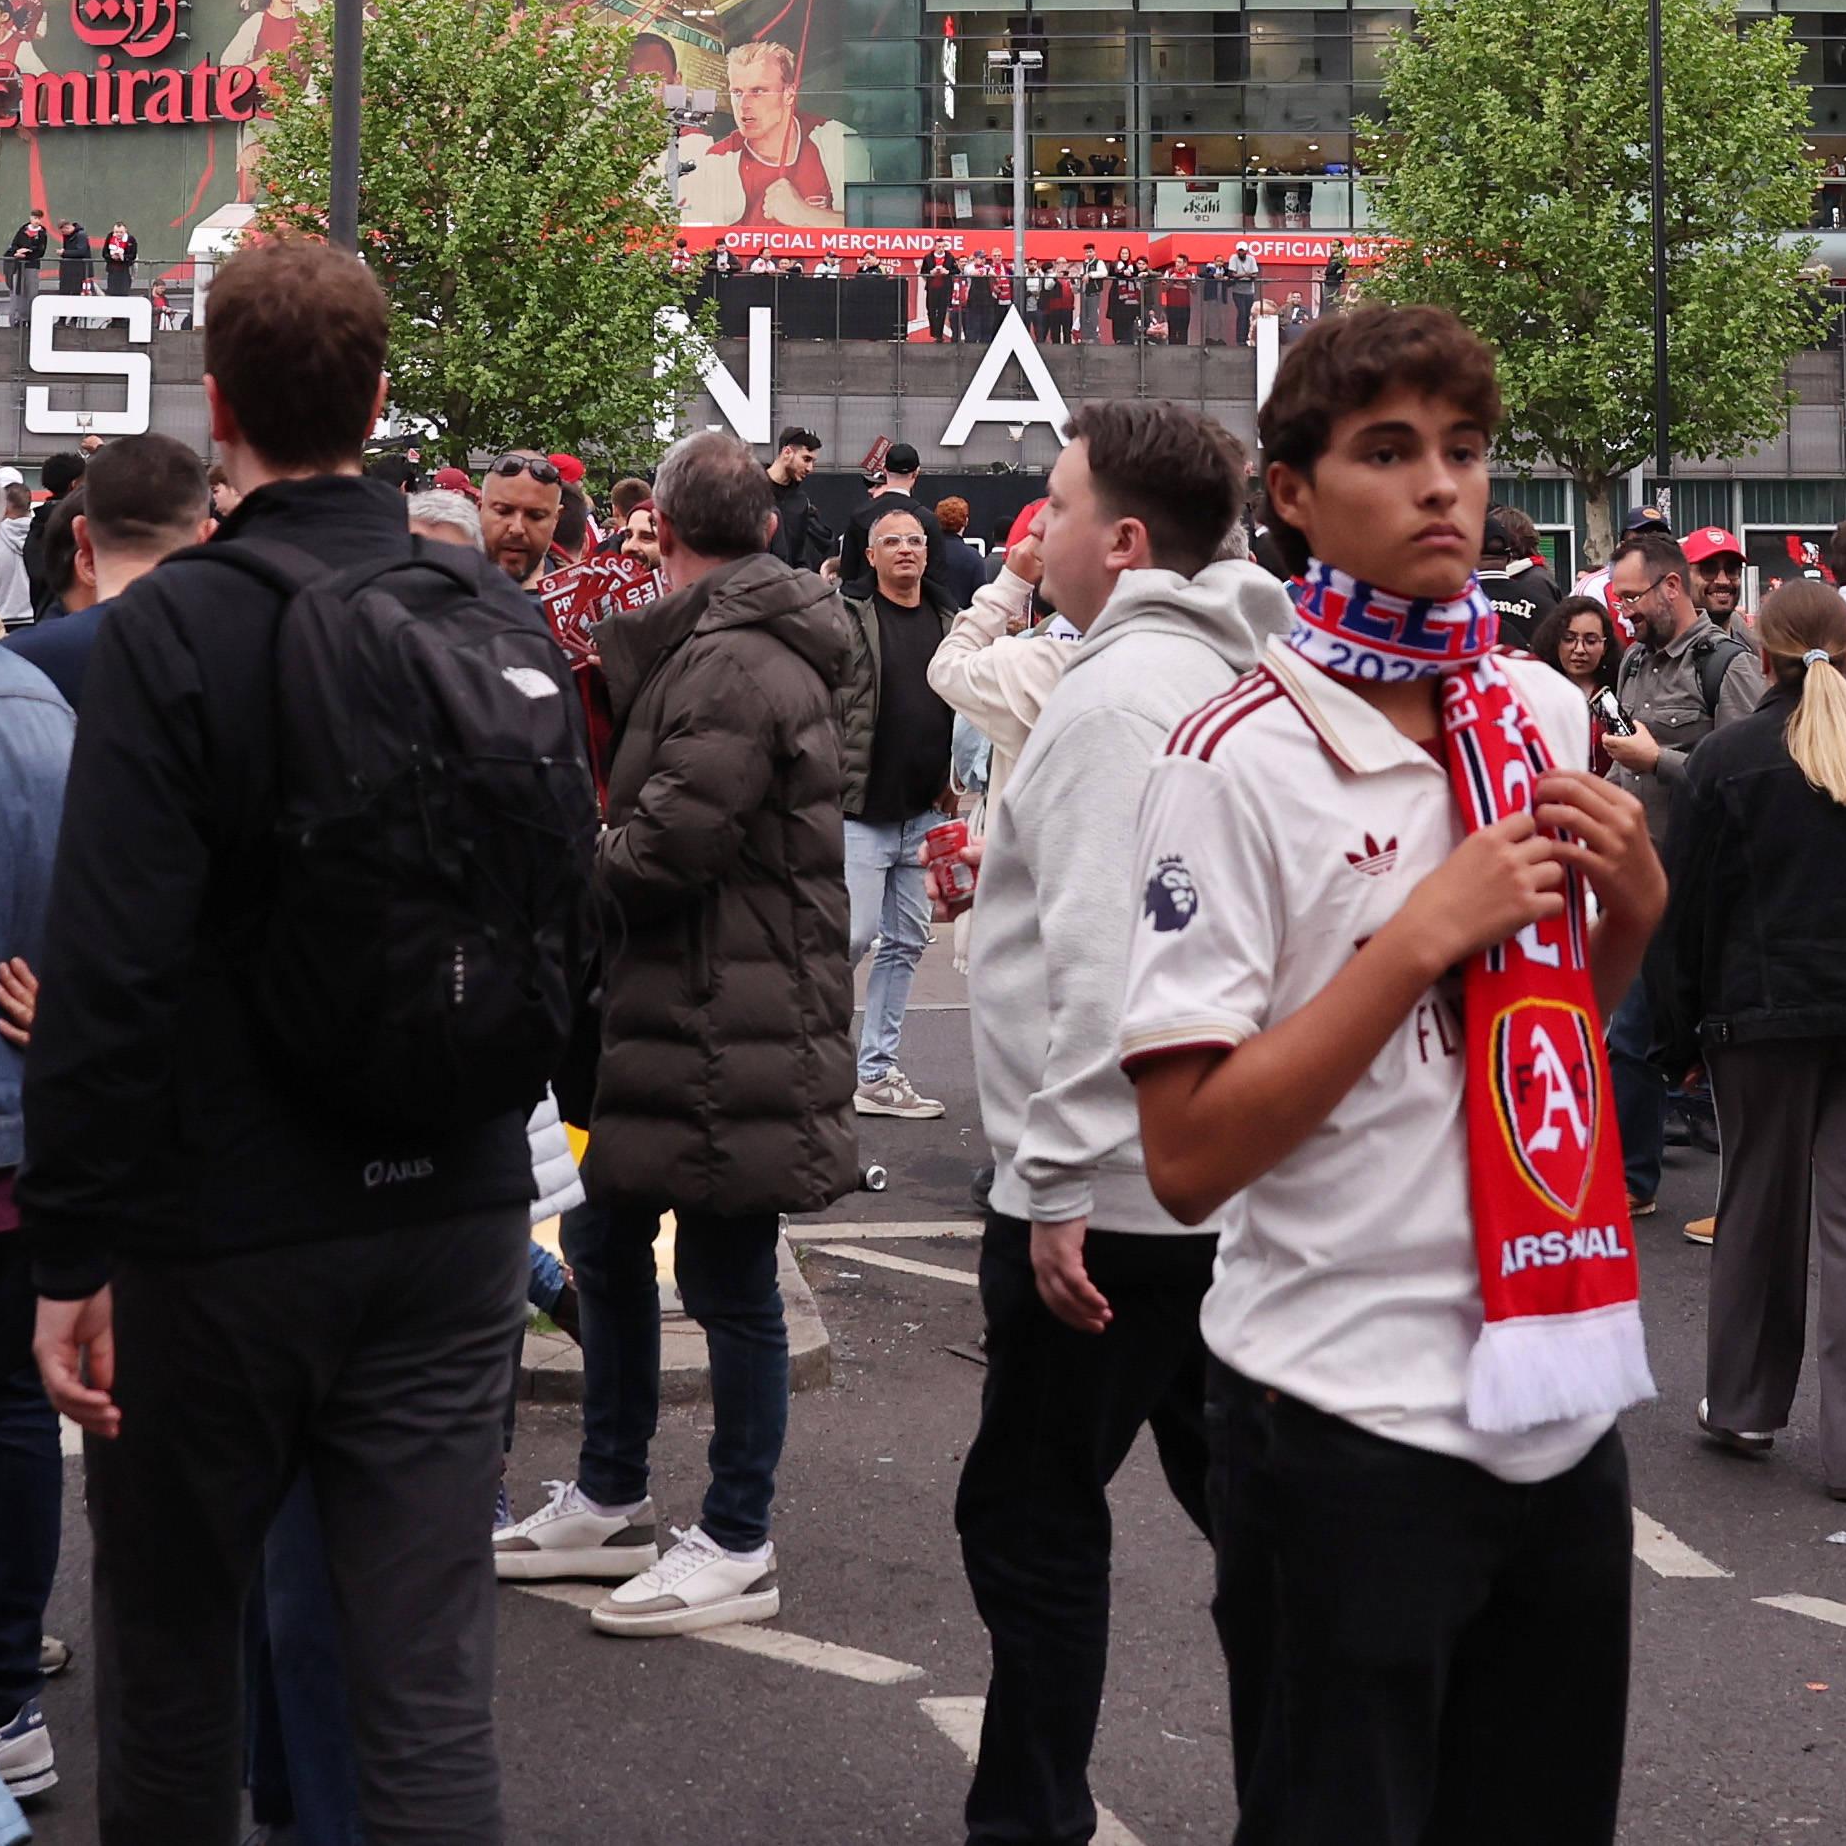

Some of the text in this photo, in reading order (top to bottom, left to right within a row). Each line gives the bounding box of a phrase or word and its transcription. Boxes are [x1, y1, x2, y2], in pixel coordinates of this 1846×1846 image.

[1183, 199, 1221, 215] Asahi
[724, 231, 815, 250] OFFICIAL
[1489, 599, 1537, 619] enal
